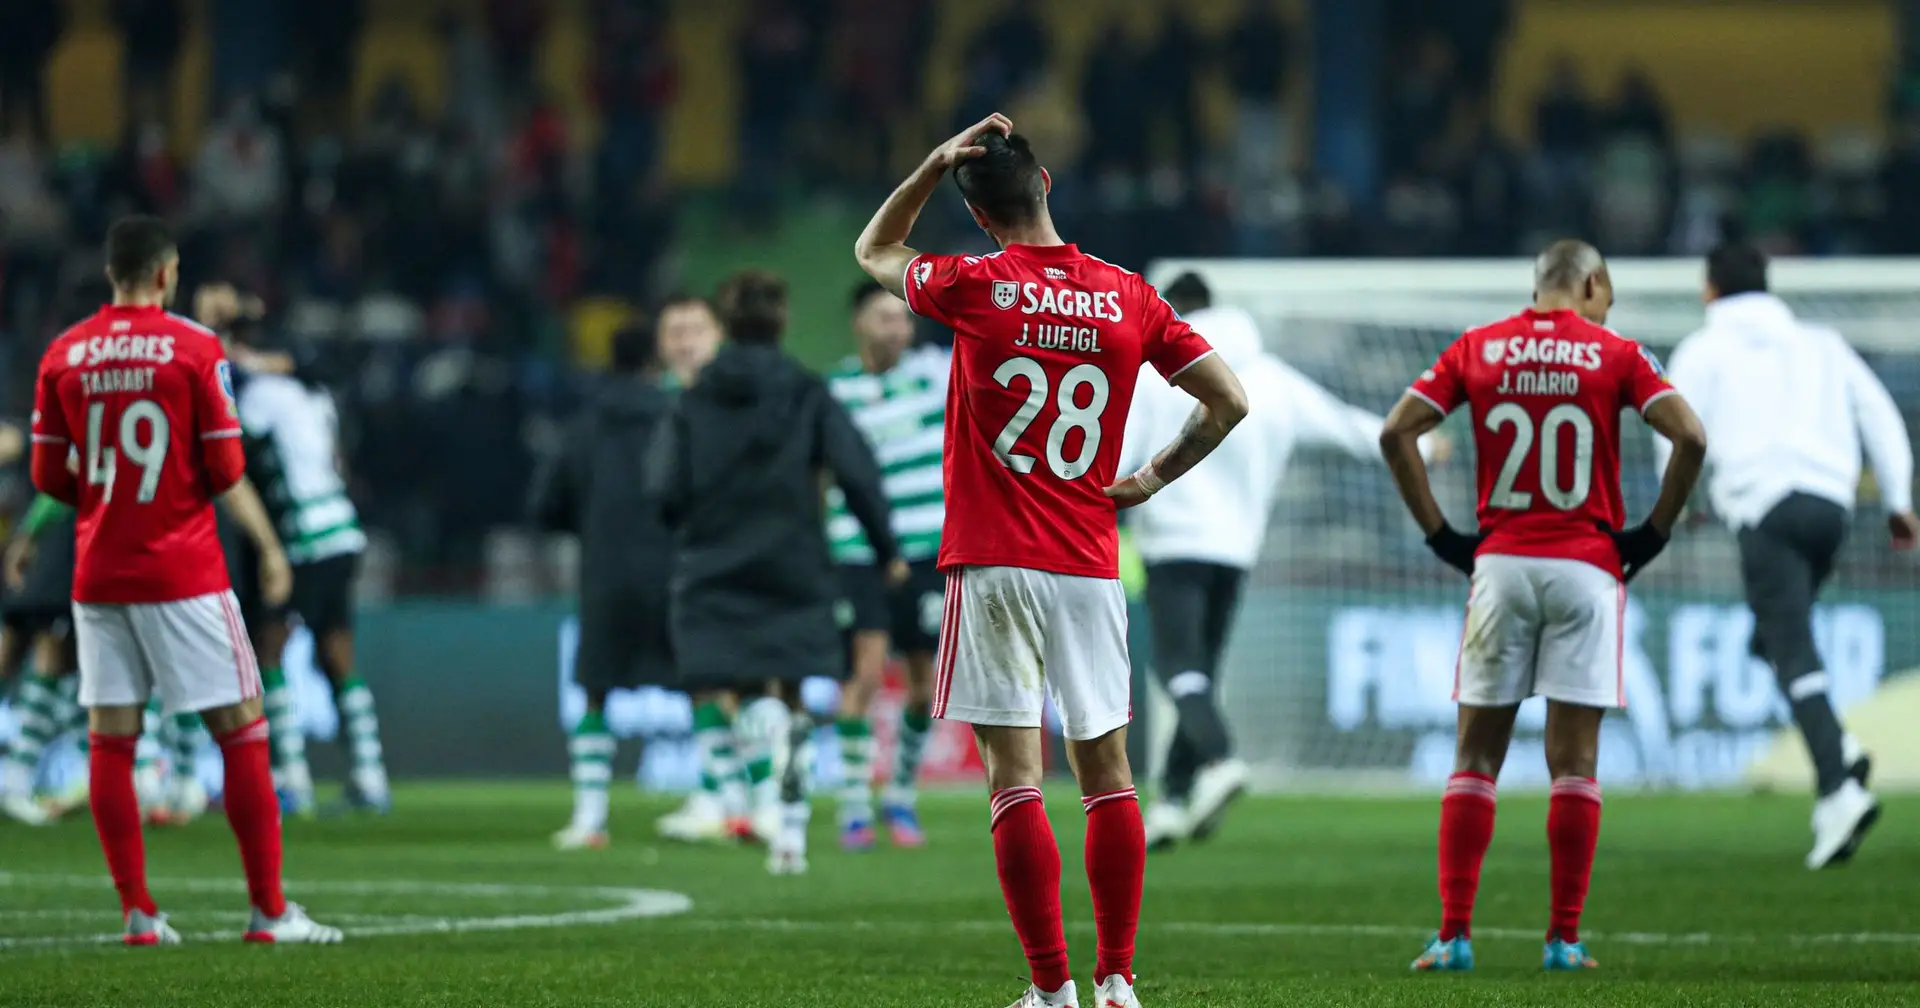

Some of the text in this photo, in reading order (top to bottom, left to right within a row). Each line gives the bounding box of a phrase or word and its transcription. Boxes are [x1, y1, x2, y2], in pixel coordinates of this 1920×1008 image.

[1021, 283, 1123, 323] SAGRES
[88, 334, 175, 366] SAGRES
[1015, 323, 1101, 352] J. WEIGL
[1507, 337, 1602, 370] SAGRES
[1498, 366, 1579, 395] J. MÁRIO
[992, 356, 1109, 480] 28
[87, 399, 169, 504] 49
[1484, 402, 1594, 511] 20
